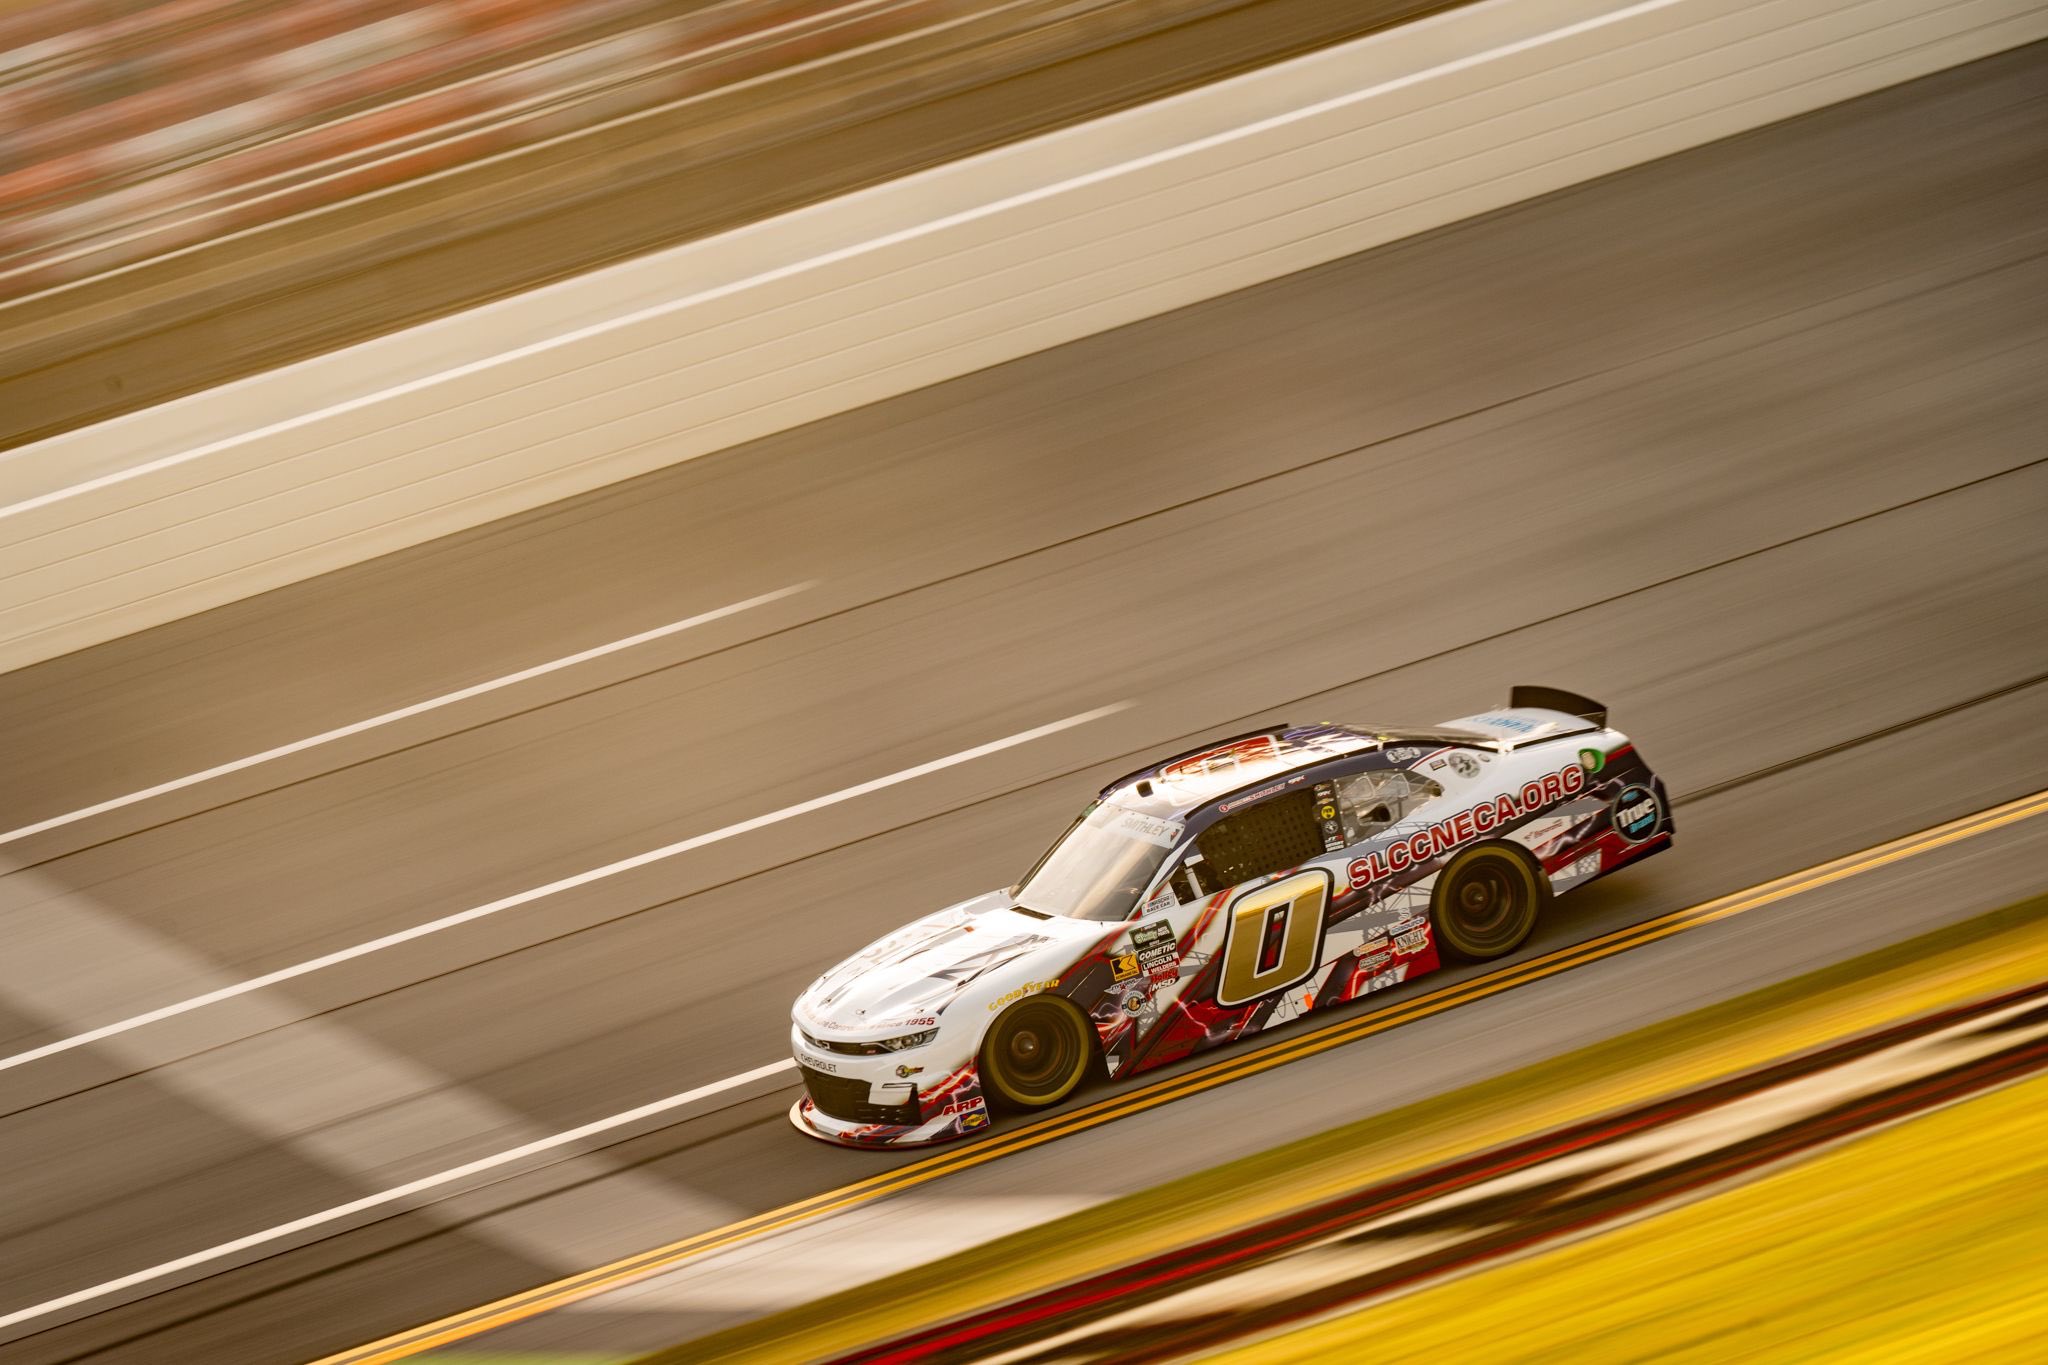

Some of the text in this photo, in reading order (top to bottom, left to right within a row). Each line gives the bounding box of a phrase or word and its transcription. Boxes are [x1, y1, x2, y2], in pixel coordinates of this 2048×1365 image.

[1616, 798, 1656, 829] True
[1121, 818, 1170, 837] SMITHLEY
[1347, 763, 1585, 890] SLCCNECA.ORG
[1217, 867, 1335, 1008] 0
[1395, 928, 1425, 950] KNIGHT
[1139, 942, 1176, 961] COMETIC
[1143, 955, 1173, 970] LINCOLN
[987, 978, 1060, 1011] GOODYEAR
[1150, 978, 1176, 992] MSD
[904, 1016, 936, 1027] 1955
[800, 1053, 837, 1073] CHEVROLET
[943, 1097, 983, 1117] ARP
